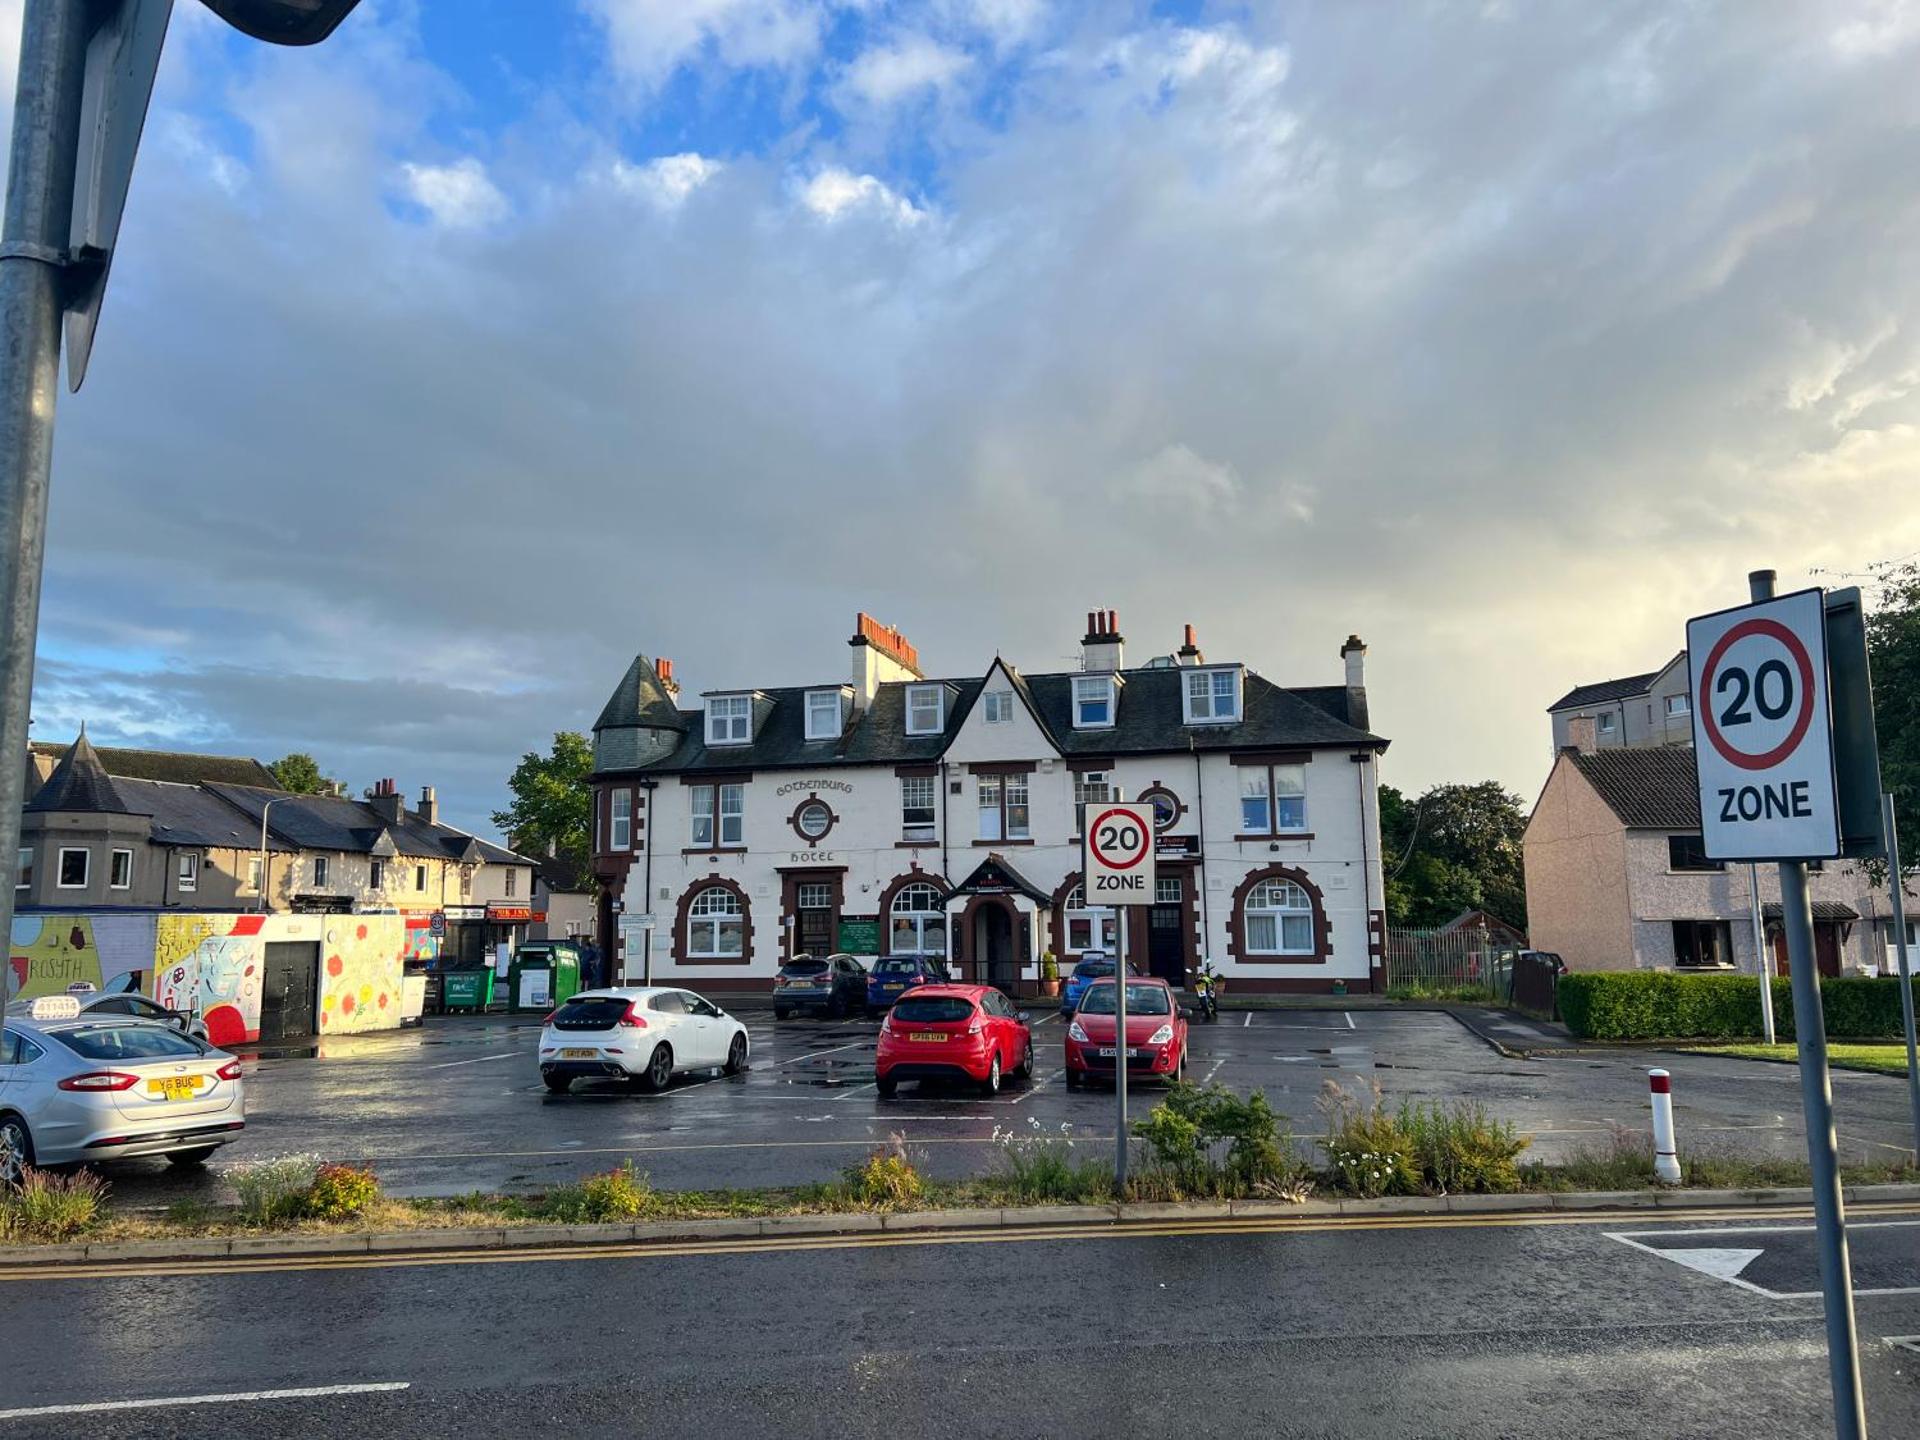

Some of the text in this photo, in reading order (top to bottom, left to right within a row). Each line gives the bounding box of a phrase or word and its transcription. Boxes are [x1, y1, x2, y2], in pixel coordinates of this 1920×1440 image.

[1717, 659, 1794, 727] 20
[776, 779, 854, 796] GOTHENBURG
[1718, 780, 1812, 823] ZONE
[1099, 826, 1139, 851] 20
[790, 852, 835, 862] HOTEL
[1096, 874, 1145, 890] ZONE
[29, 958, 82, 980] ROSYTH
